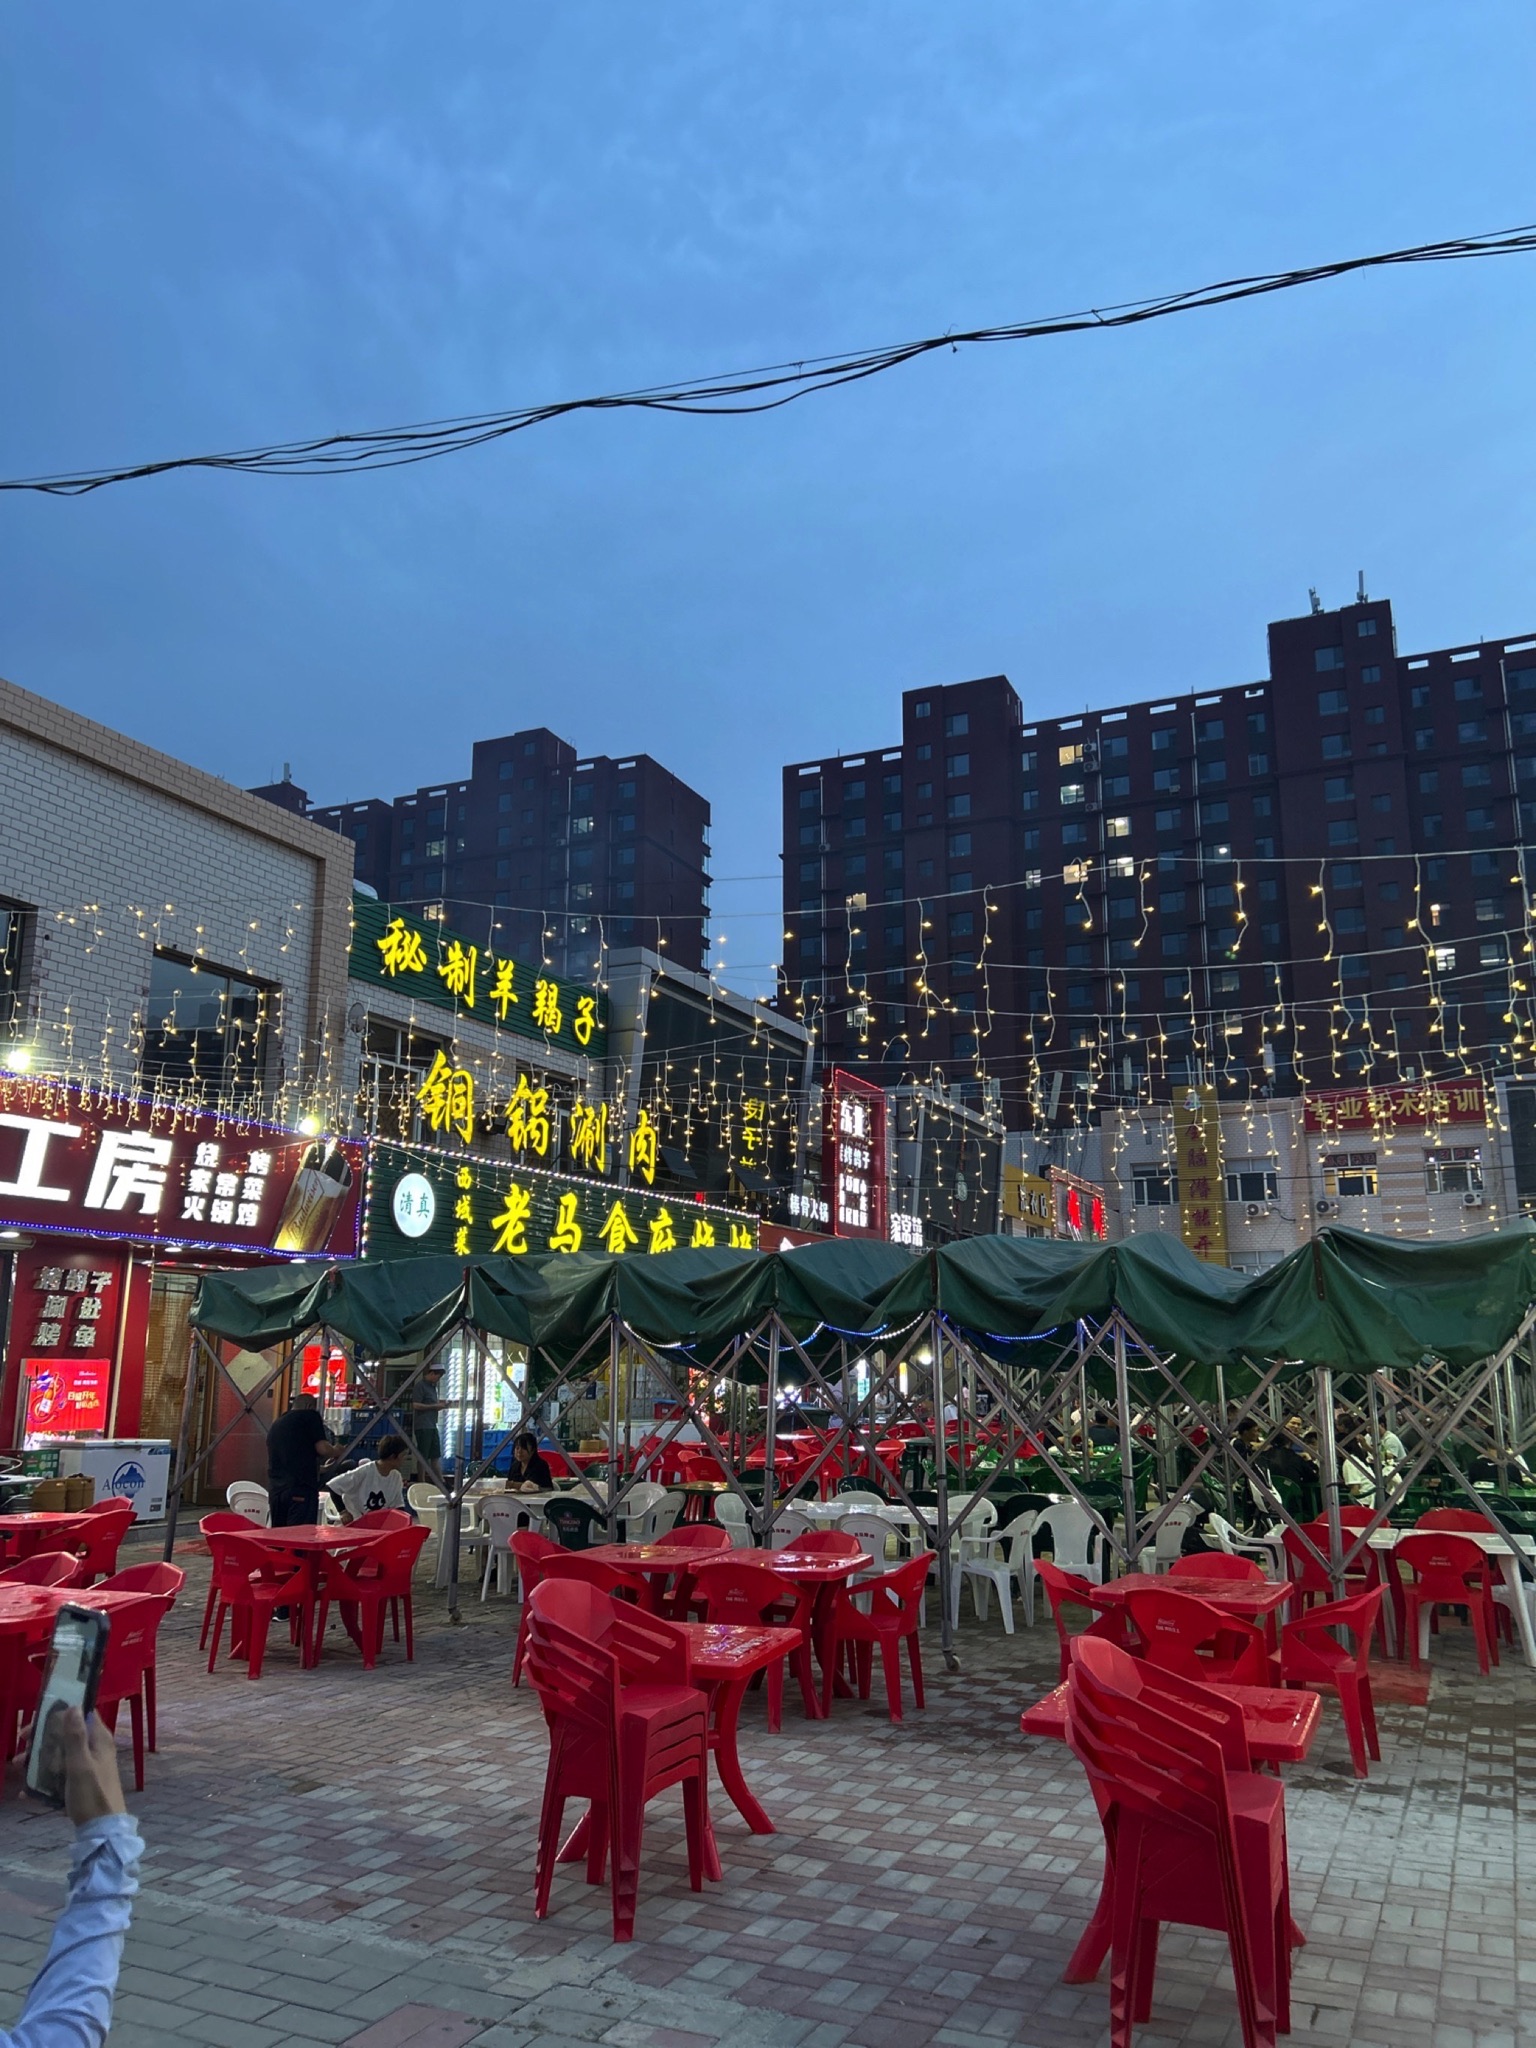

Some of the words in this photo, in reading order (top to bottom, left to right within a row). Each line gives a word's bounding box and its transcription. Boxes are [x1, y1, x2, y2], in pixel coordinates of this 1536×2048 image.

[415, 1049, 657, 1185] 铜锅涮肉
[1309, 1087, 1480, 1123] 专业艺术培训
[0, 1113, 173, 1215] 工房
[187, 1168, 265, 1201] 家常菜
[181, 1195, 259, 1227] 火锅鸡
[400, 1190, 430, 1218] 清真
